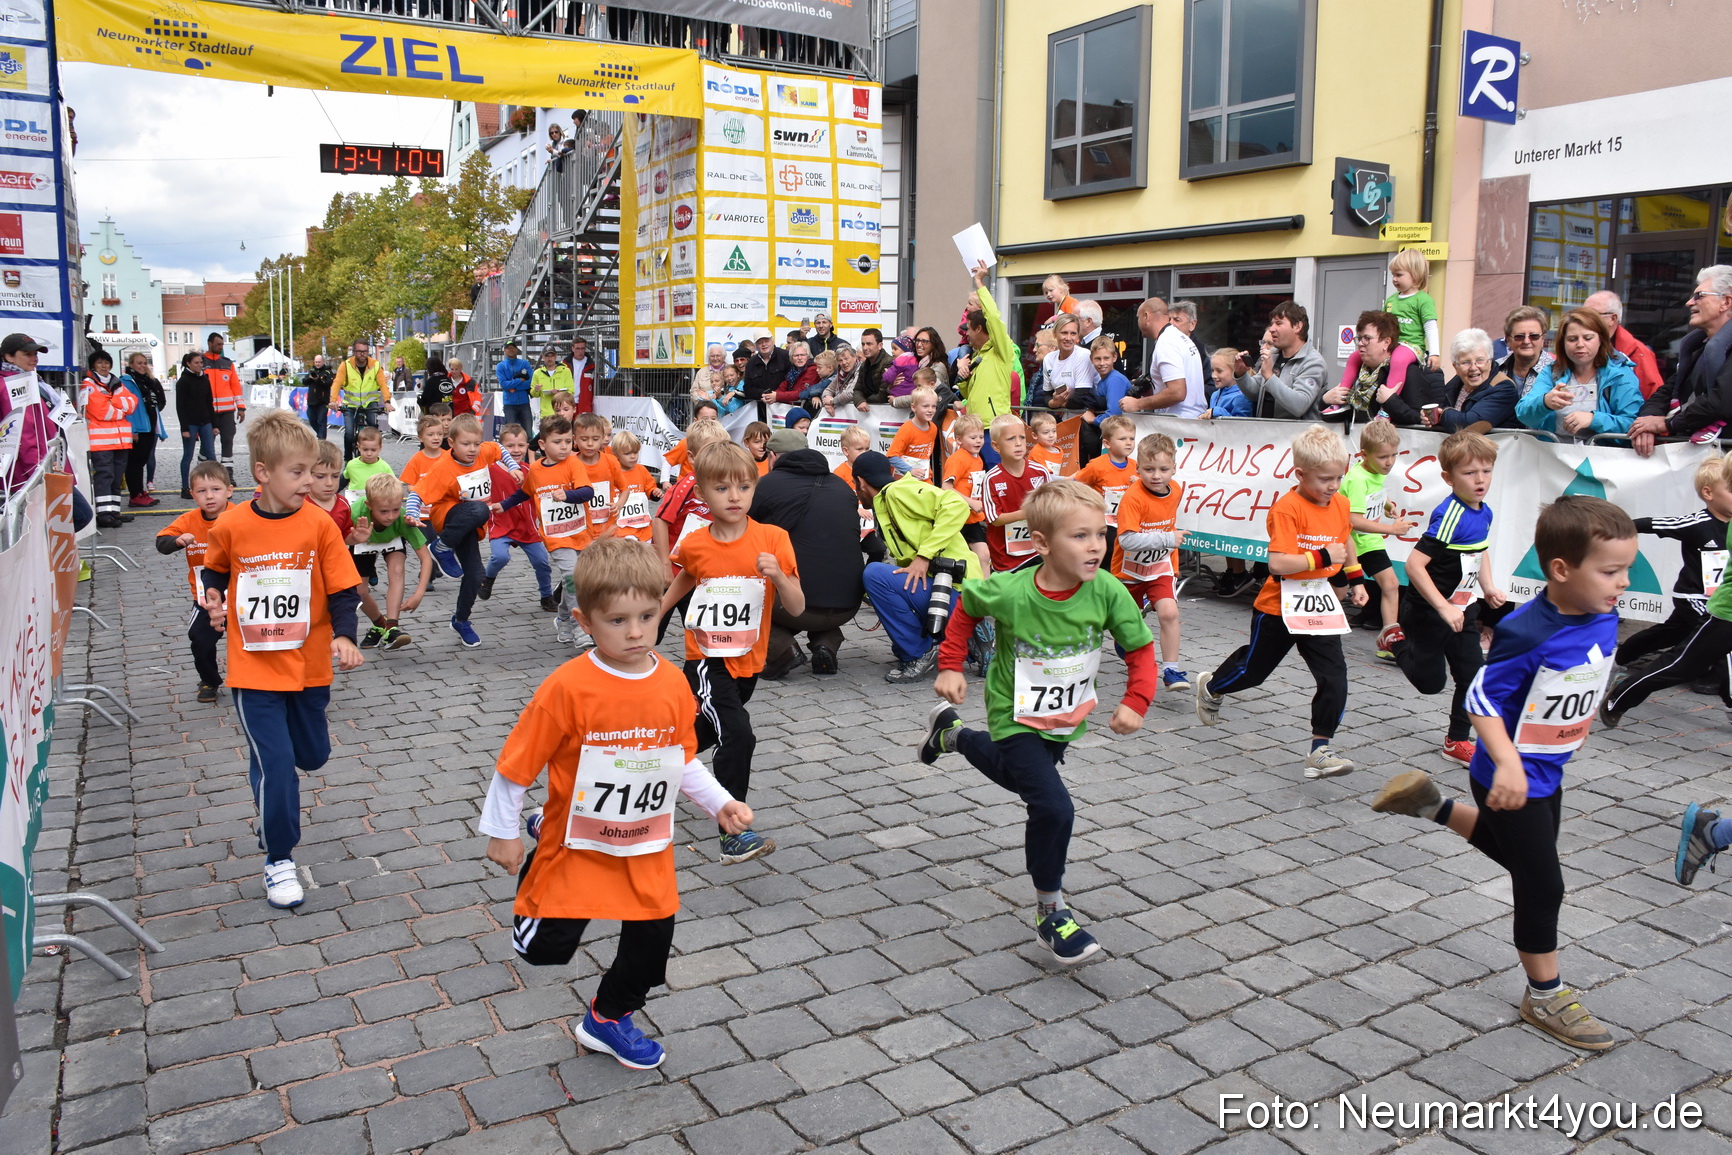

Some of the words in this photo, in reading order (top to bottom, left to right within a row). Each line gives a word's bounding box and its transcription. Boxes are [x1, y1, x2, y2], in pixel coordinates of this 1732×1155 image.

[97, 28, 184, 51] Neumarkter
[188, 41, 254, 56] Stadtlauf
[340, 34, 484, 84] ZIEL
[557, 73, 621, 90] Neumarkter
[625, 82, 675, 91] Stadtlauf
[0, 119, 47, 134] DL
[5, 132, 47, 143] energie
[773, 130, 809, 143] swn
[1514, 147, 1560, 165] Unterer
[1565, 139, 1602, 158] Markt
[1607, 136, 1622, 152] 15
[805, 172, 823, 180] CODE
[723, 214, 765, 224] VARIOTEC
[1388, 225, 1430, 233] Startnummern-
[112, 335, 147, 345] Laufsport
[1199, 442, 1274, 476] UNS
[468, 481, 491, 499] 718
[1177, 481, 1279, 521] FACH
[547, 503, 580, 521] 7284
[1012, 527, 1030, 539] 72
[1181, 536, 1243, 554] ervice-Line:
[238, 551, 294, 564] Neumarkter
[1509, 582, 1530, 596] Jura
[248, 594, 300, 620] 7169
[1292, 594, 1335, 613] 7030
[1629, 598, 1662, 614] GmbH
[696, 603, 751, 627] 7194
[260, 627, 285, 637] Moritz
[711, 634, 732, 643] Eliah
[1030, 677, 1091, 712] 7317
[627, 758, 661, 770] BOCK
[593, 780, 668, 815] 7149
[599, 825, 650, 839] Johannes
